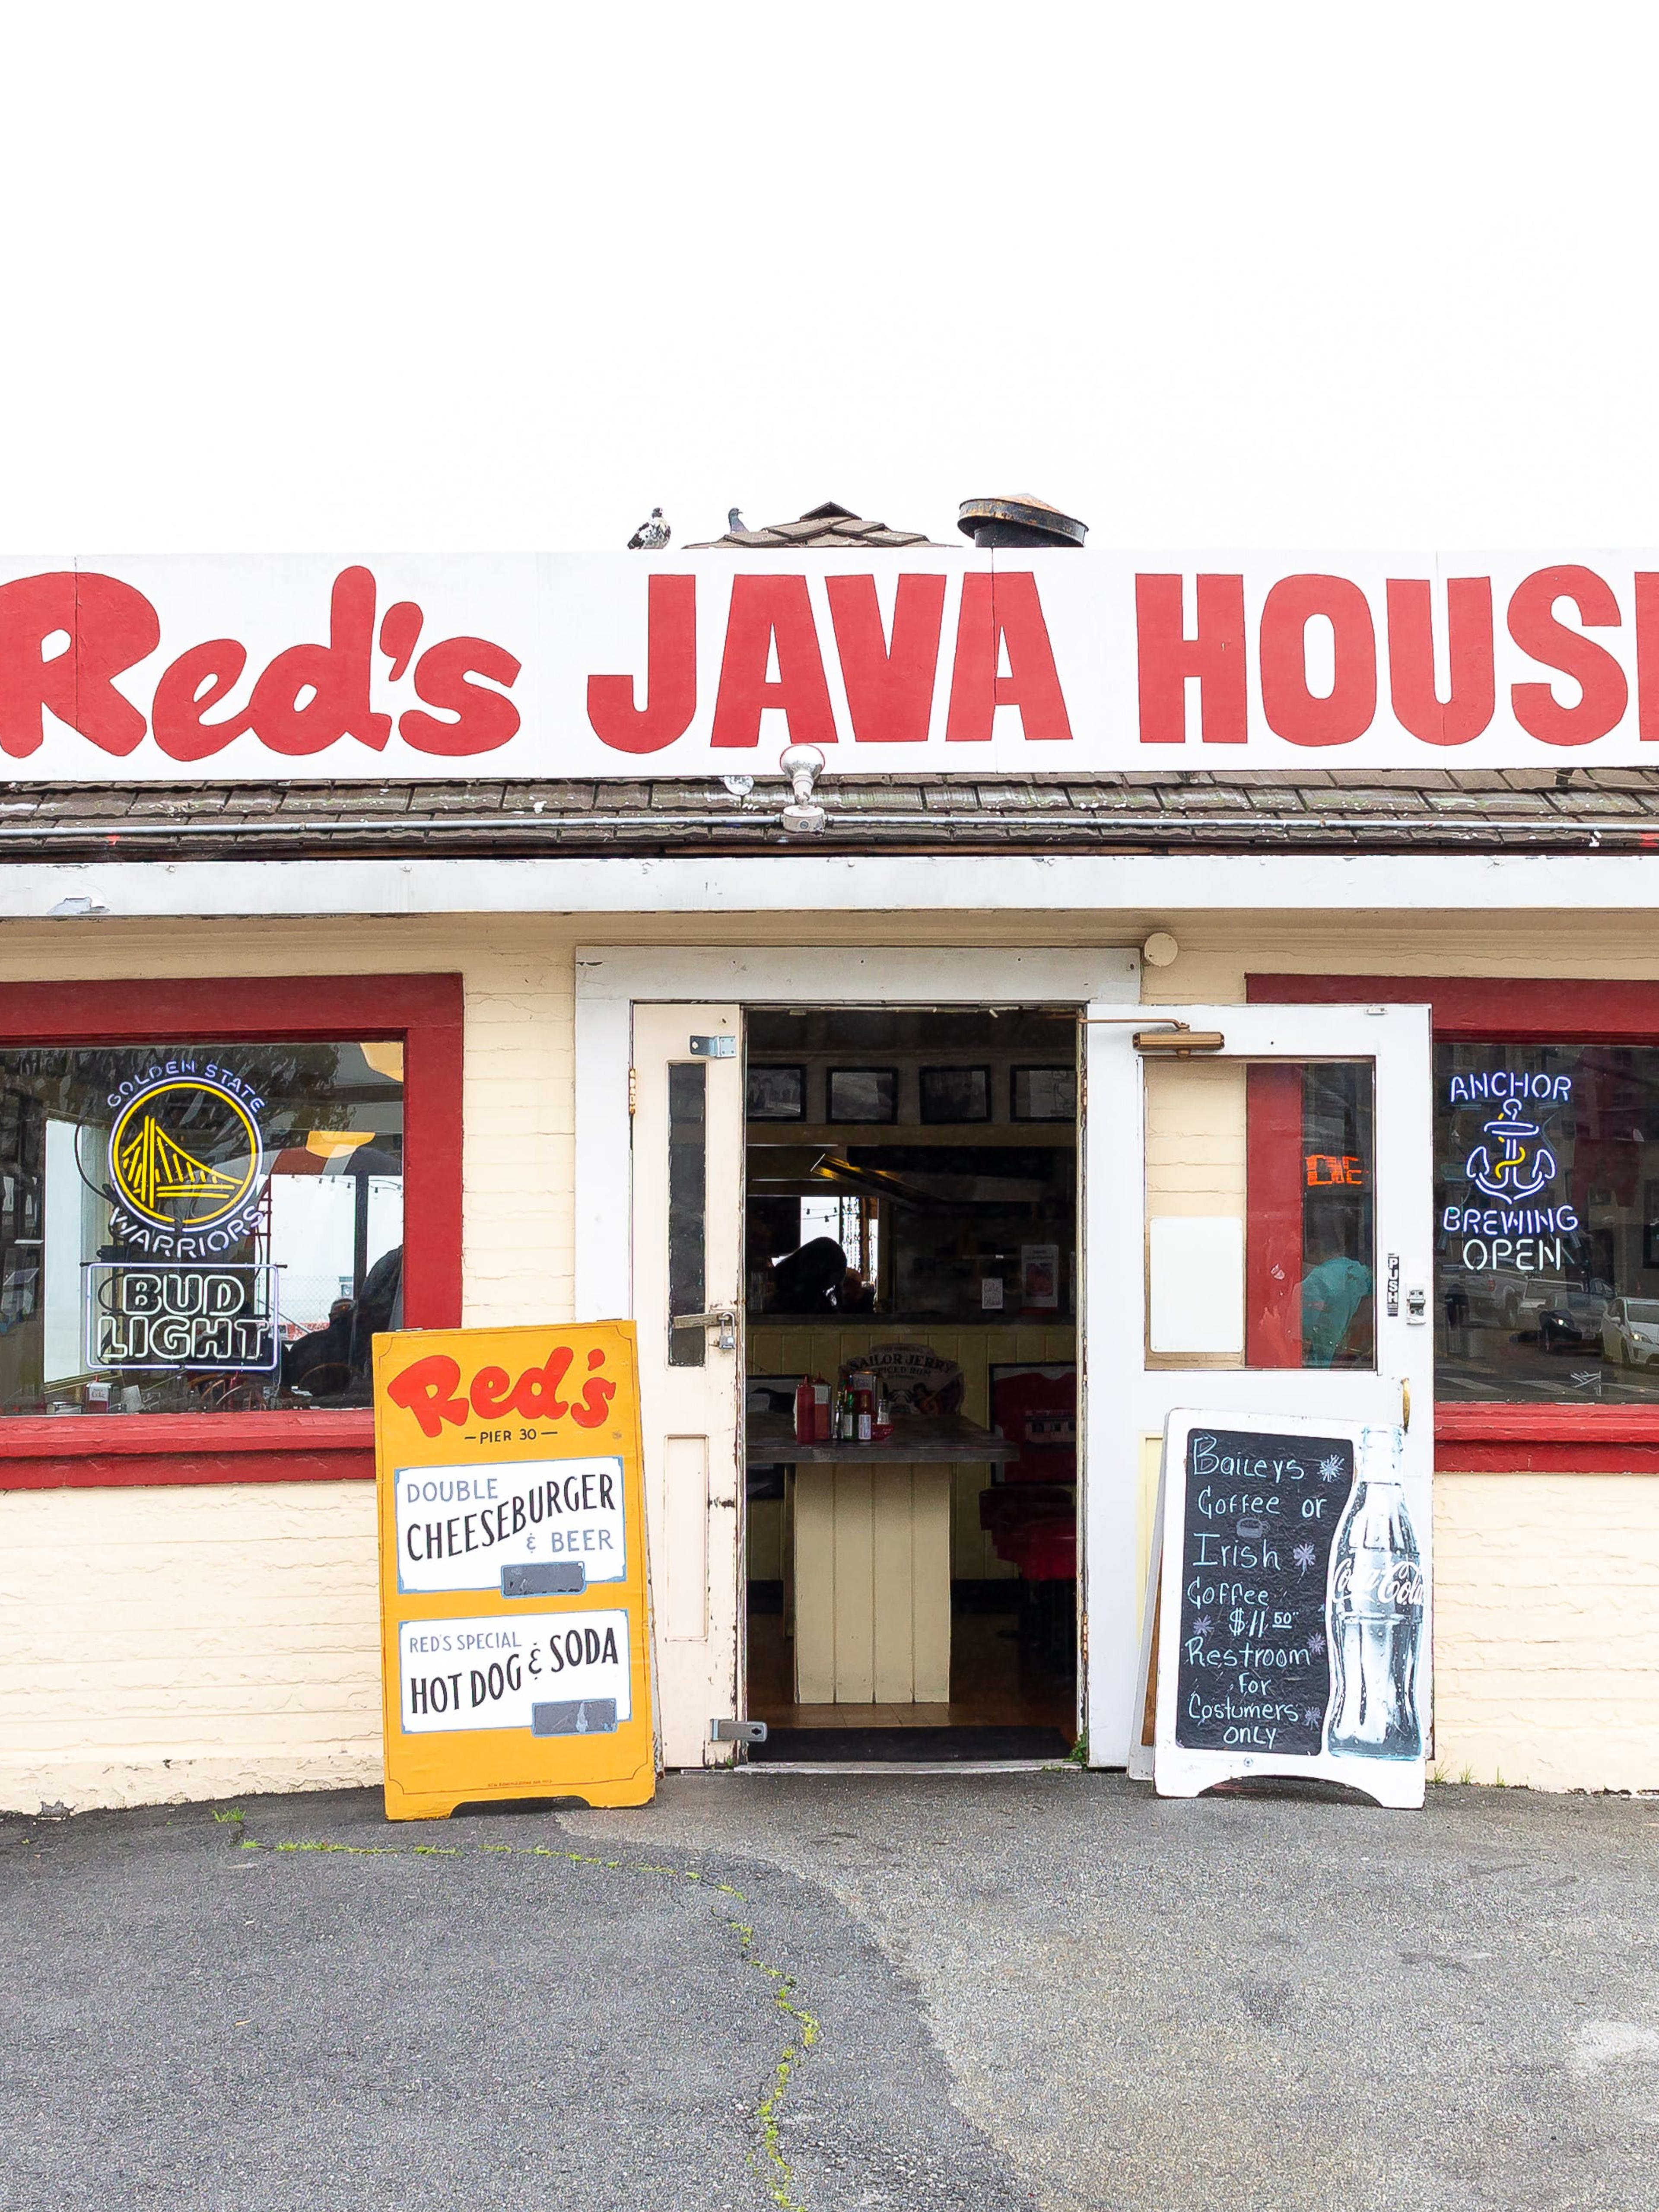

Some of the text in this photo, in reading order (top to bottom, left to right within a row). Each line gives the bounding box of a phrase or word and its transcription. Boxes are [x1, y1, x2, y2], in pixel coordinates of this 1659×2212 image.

[0, 565, 1659, 761] Red's JAVA HOUS
[107, 1061, 265, 1114] GOLDEN STATE
[1450, 1072, 1572, 1103] ANCHOR
[108, 1205, 265, 1259] WARRIORS
[1443, 1205, 1578, 1235] BREWING
[1463, 1238, 1560, 1271] OPEN
[123, 1274, 244, 1316] BUD
[1388, 1257, 1399, 1303] PUSH
[97, 1316, 269, 1360] LIGHT
[849, 1354, 955, 1373] SAILOR JERRY
[387, 1346, 616, 1438] Red's
[480, 1429, 537, 1444] PIER 30
[407, 1478, 498, 1503] DOUBLE
[1198, 1485, 1328, 1519] Coffee or
[407, 1474, 616, 1561] CHEESEBURGER
[552, 1529, 613, 1553] BEER
[1193, 1533, 1281, 1570] Irish
[1188, 1576, 1268, 1609] Coffee
[1332, 1558, 1424, 1605] CoCola
[410, 1631, 522, 1653] RED'S SPECIAL
[1185, 1636, 1310, 1667] Restroom
[411, 1627, 618, 1714] HOT DOG & SODA
[1189, 1693, 1299, 1722] Costumers
